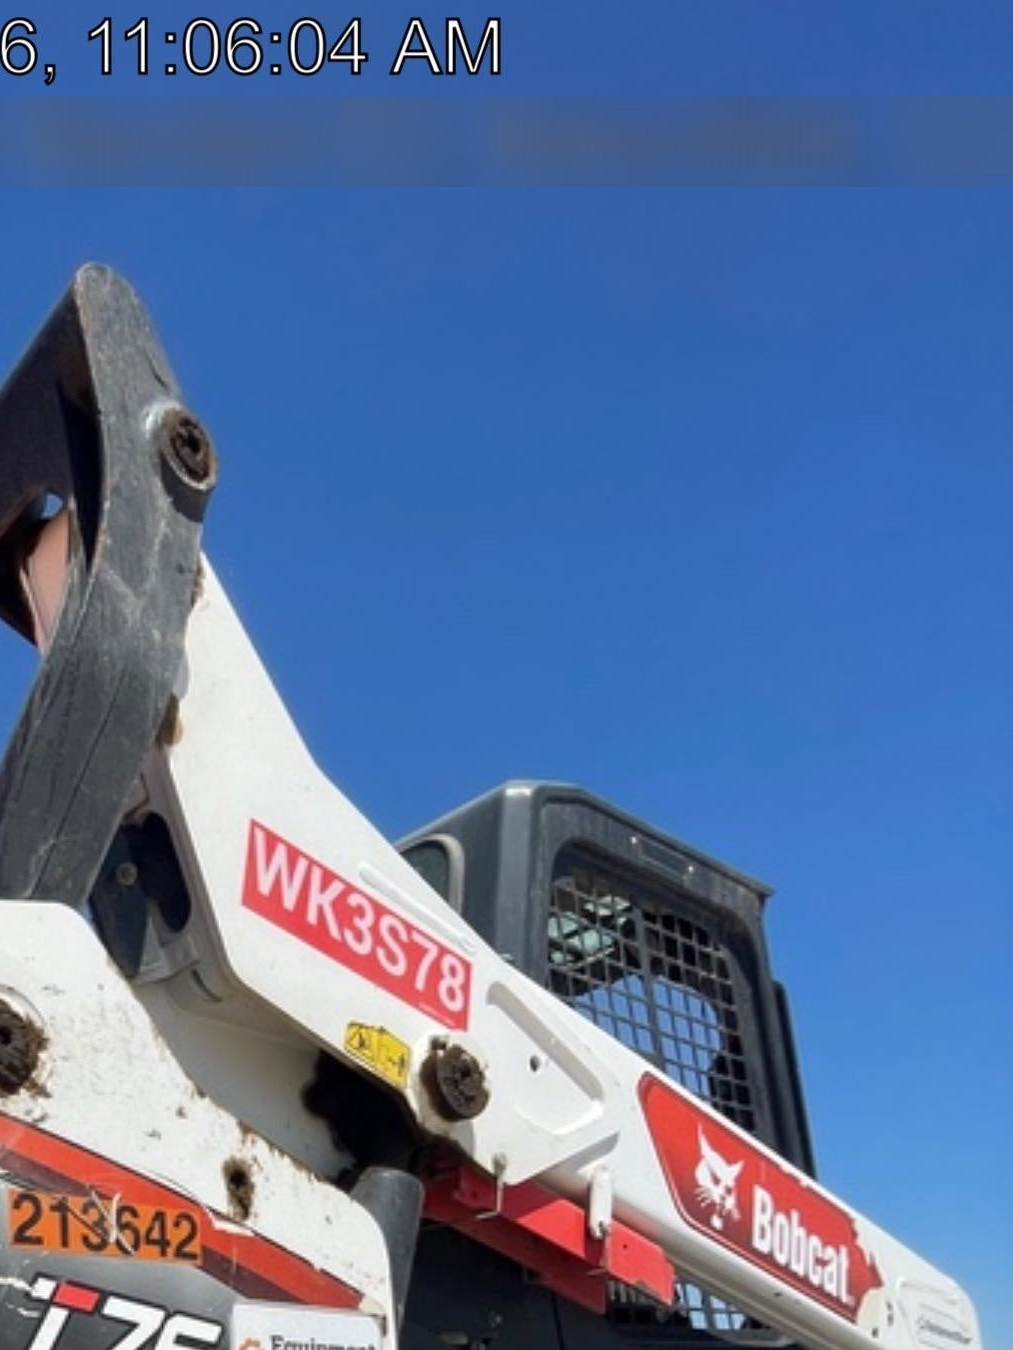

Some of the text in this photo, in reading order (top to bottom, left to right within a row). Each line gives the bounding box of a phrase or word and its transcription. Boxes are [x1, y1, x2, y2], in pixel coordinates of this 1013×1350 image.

[252, 825, 466, 1013] WK3S78
[12, 1193, 199, 1260] 213642
[751, 1184, 851, 1303] Bobcat
